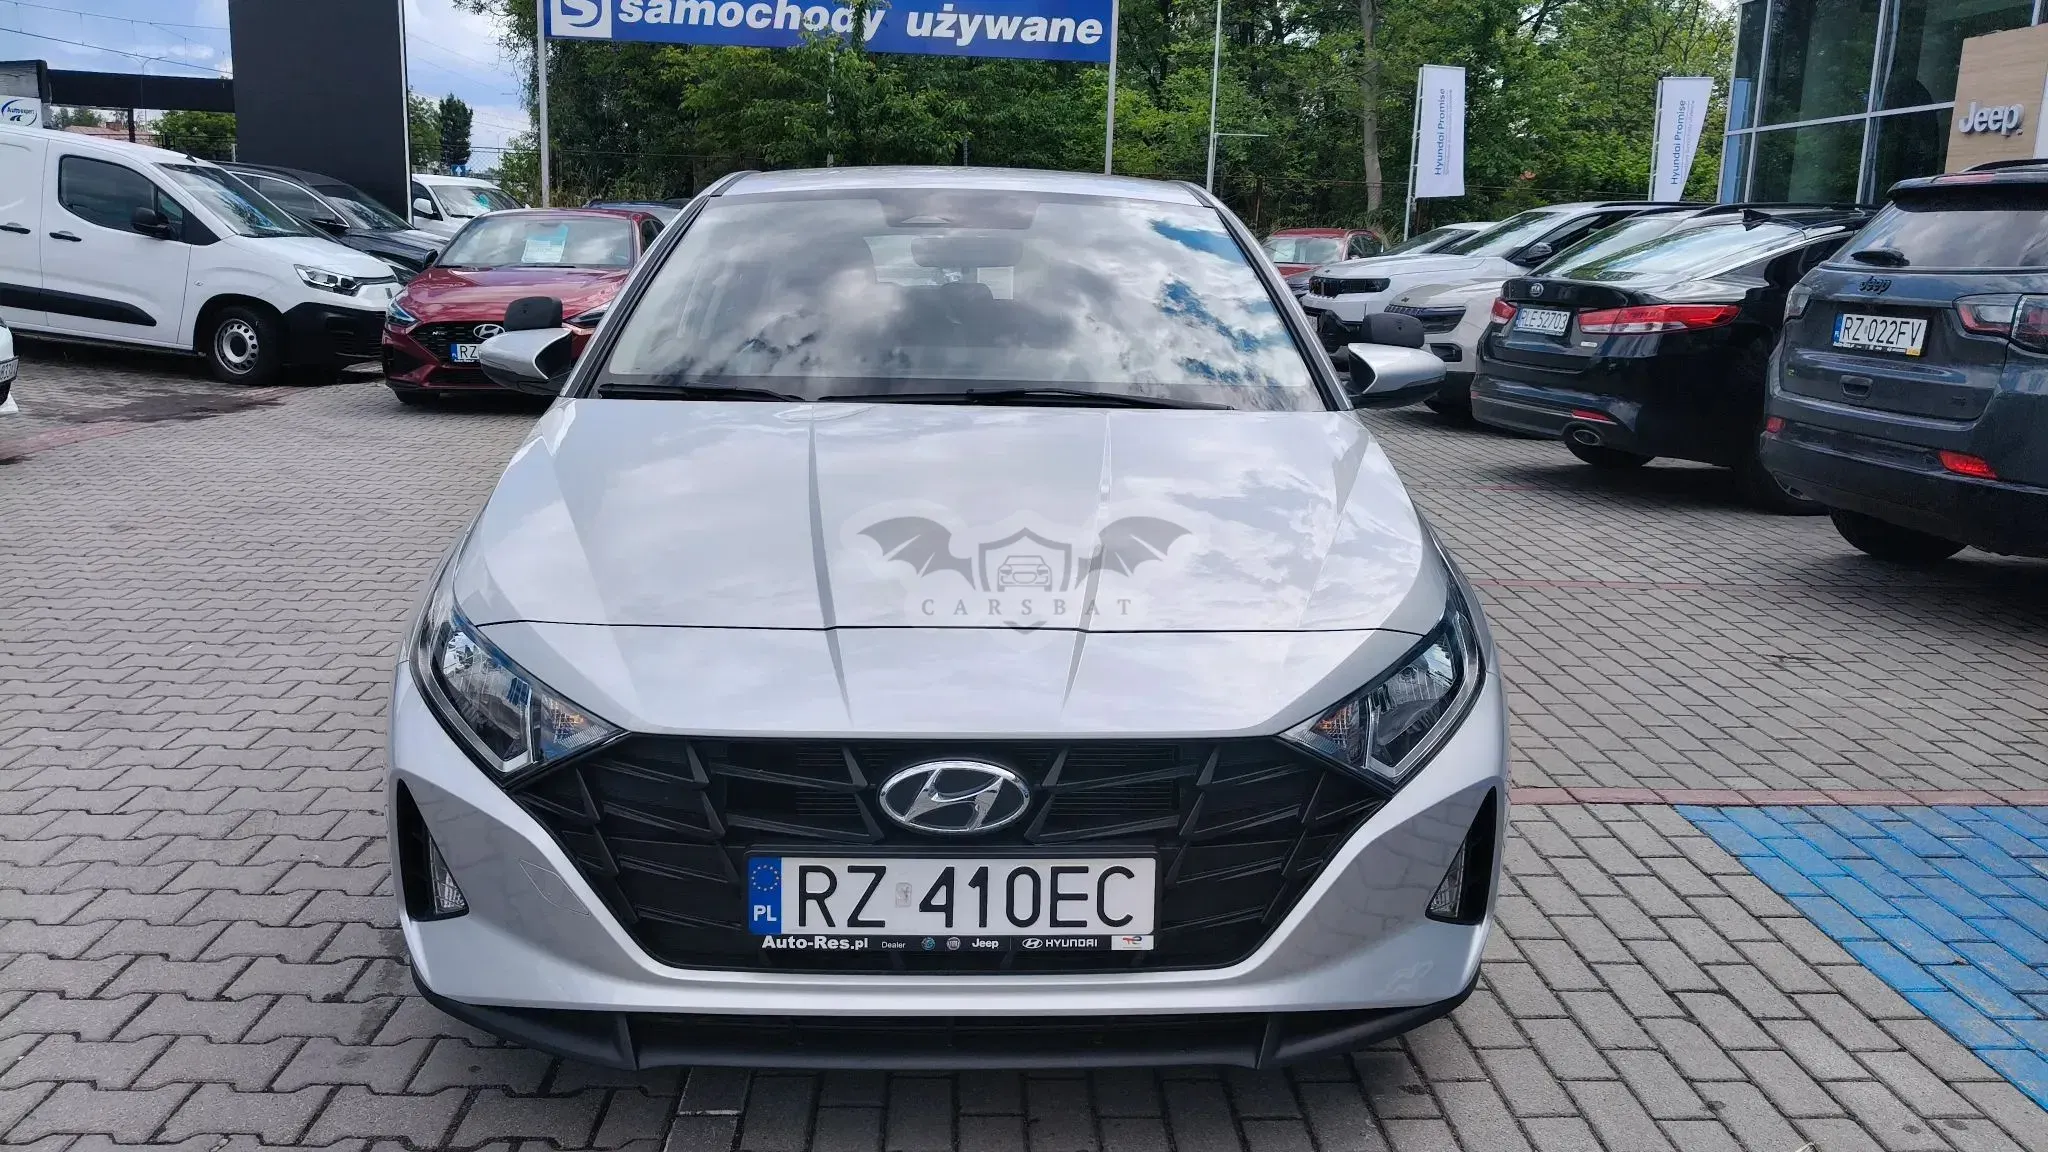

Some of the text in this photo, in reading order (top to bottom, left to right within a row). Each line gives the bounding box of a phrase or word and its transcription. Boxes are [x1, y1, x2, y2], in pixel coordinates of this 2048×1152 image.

[618, 0, 1103, 47] samochody używane
[1434, 88, 1446, 176] Hyundai Promise
[1958, 102, 2025, 136] Jeep
[1670, 100, 1686, 185] Hyundai Promise
[1842, 316, 1865, 341] RZ
[1867, 318, 1922, 347] 022FV
[459, 345, 478, 359] RZ
[753, 904, 777, 922] PL
[798, 865, 1135, 928] RZ 410EC
[761, 935, 869, 950] Auto-Res.pl
[881, 941, 906, 949] Dealer
[971, 938, 1000, 949] Jeep
[1045, 938, 1098, 948] HYUNDAI
